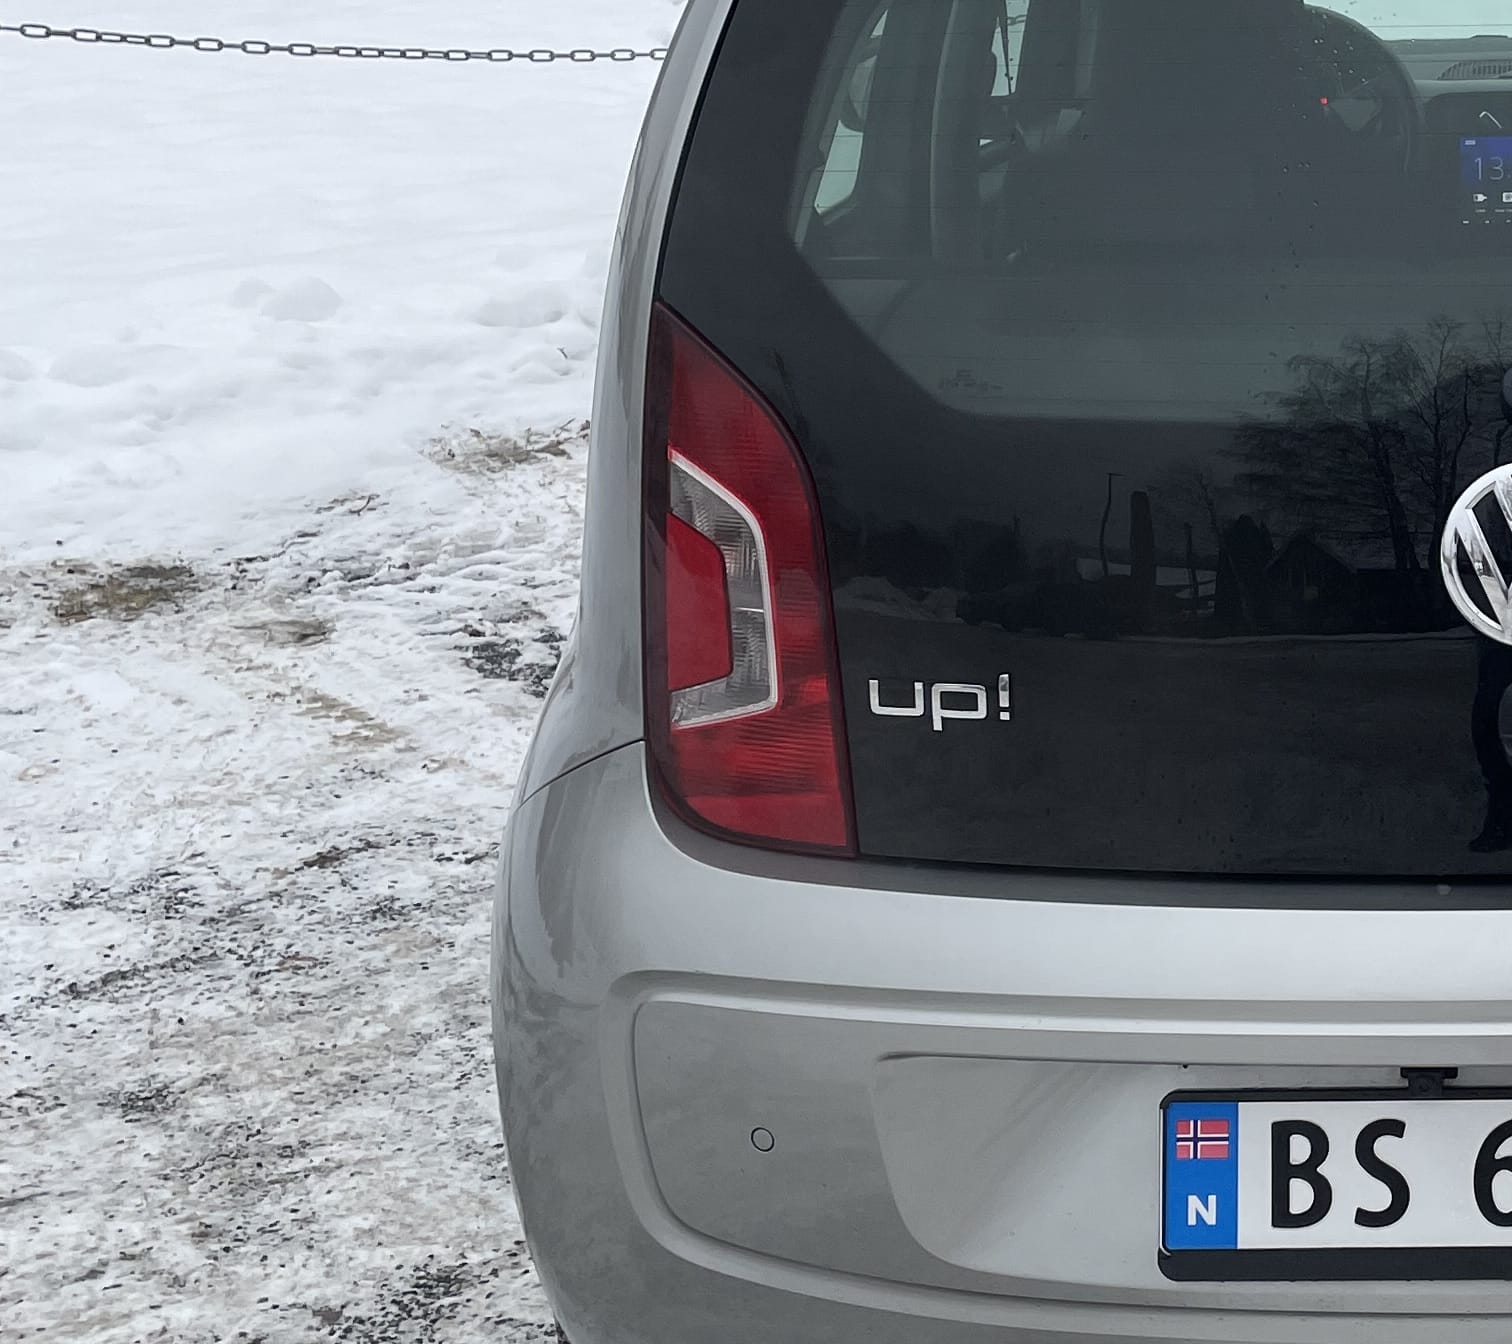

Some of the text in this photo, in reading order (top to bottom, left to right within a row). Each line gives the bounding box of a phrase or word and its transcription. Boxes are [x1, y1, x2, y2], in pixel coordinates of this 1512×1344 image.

[869, 674, 1011, 731] up!
[1270, 1119, 1411, 1229] BS
[1187, 1195, 1217, 1226] N
